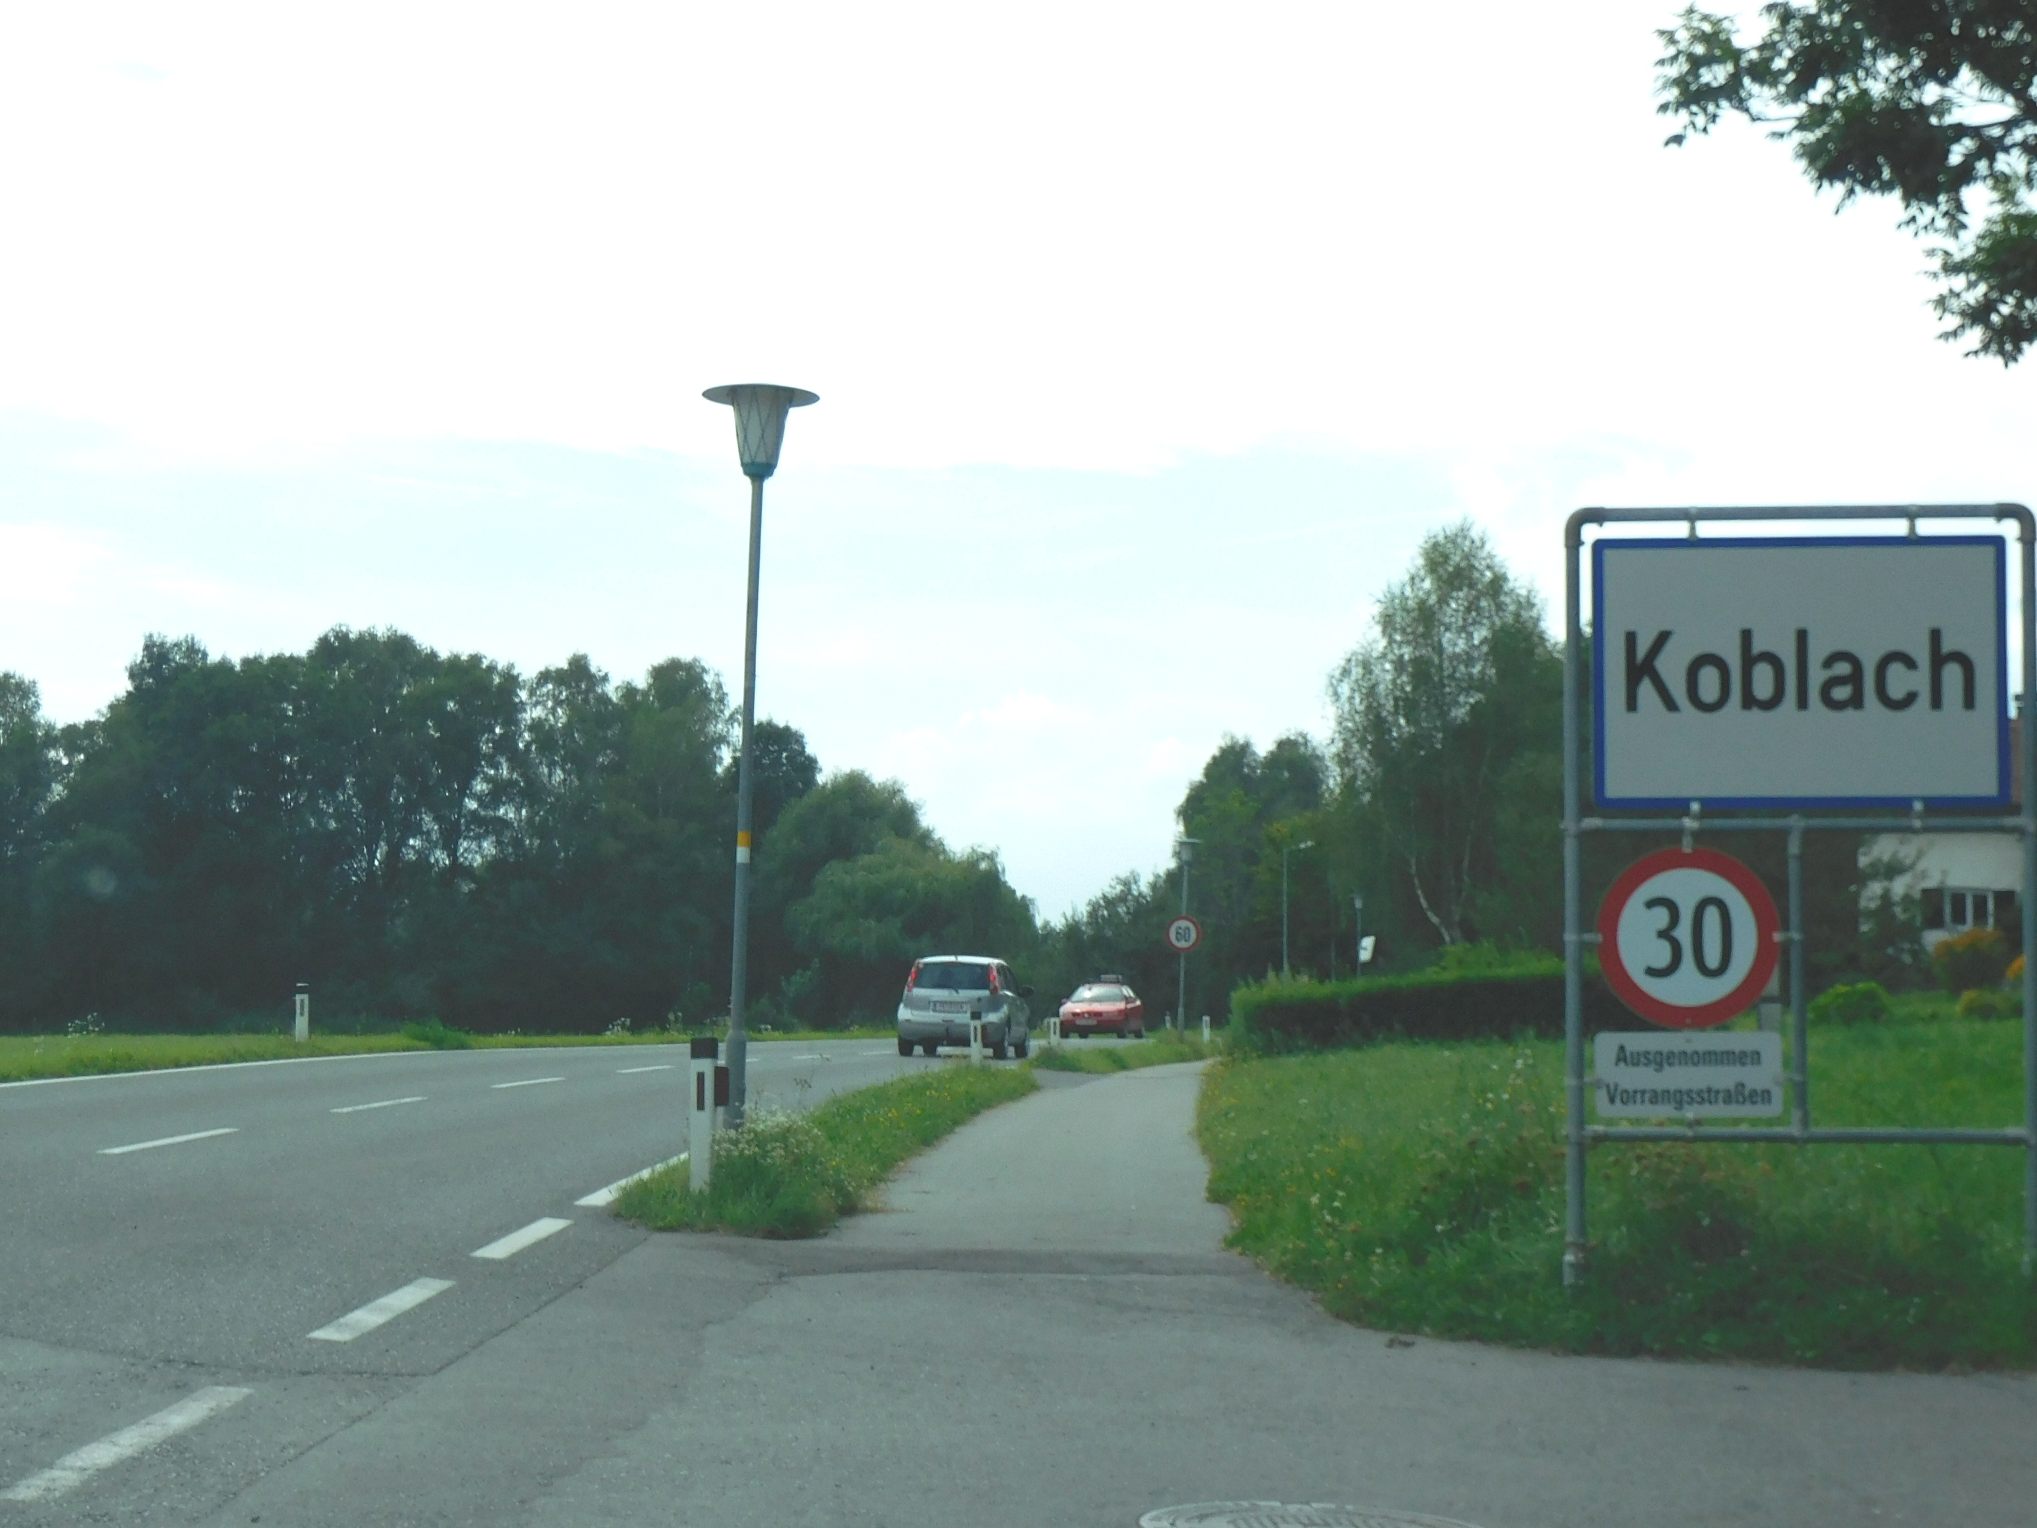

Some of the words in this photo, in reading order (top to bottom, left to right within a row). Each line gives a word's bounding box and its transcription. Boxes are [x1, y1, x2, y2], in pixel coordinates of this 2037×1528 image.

[1624, 627, 1976, 713] Koblach
[1175, 926, 1191, 942] 60
[1643, 896, 1733, 978] 30
[1615, 1044, 1762, 1073] Ausgenommen
[1605, 1082, 1773, 1111] Vorrangsstraßen
